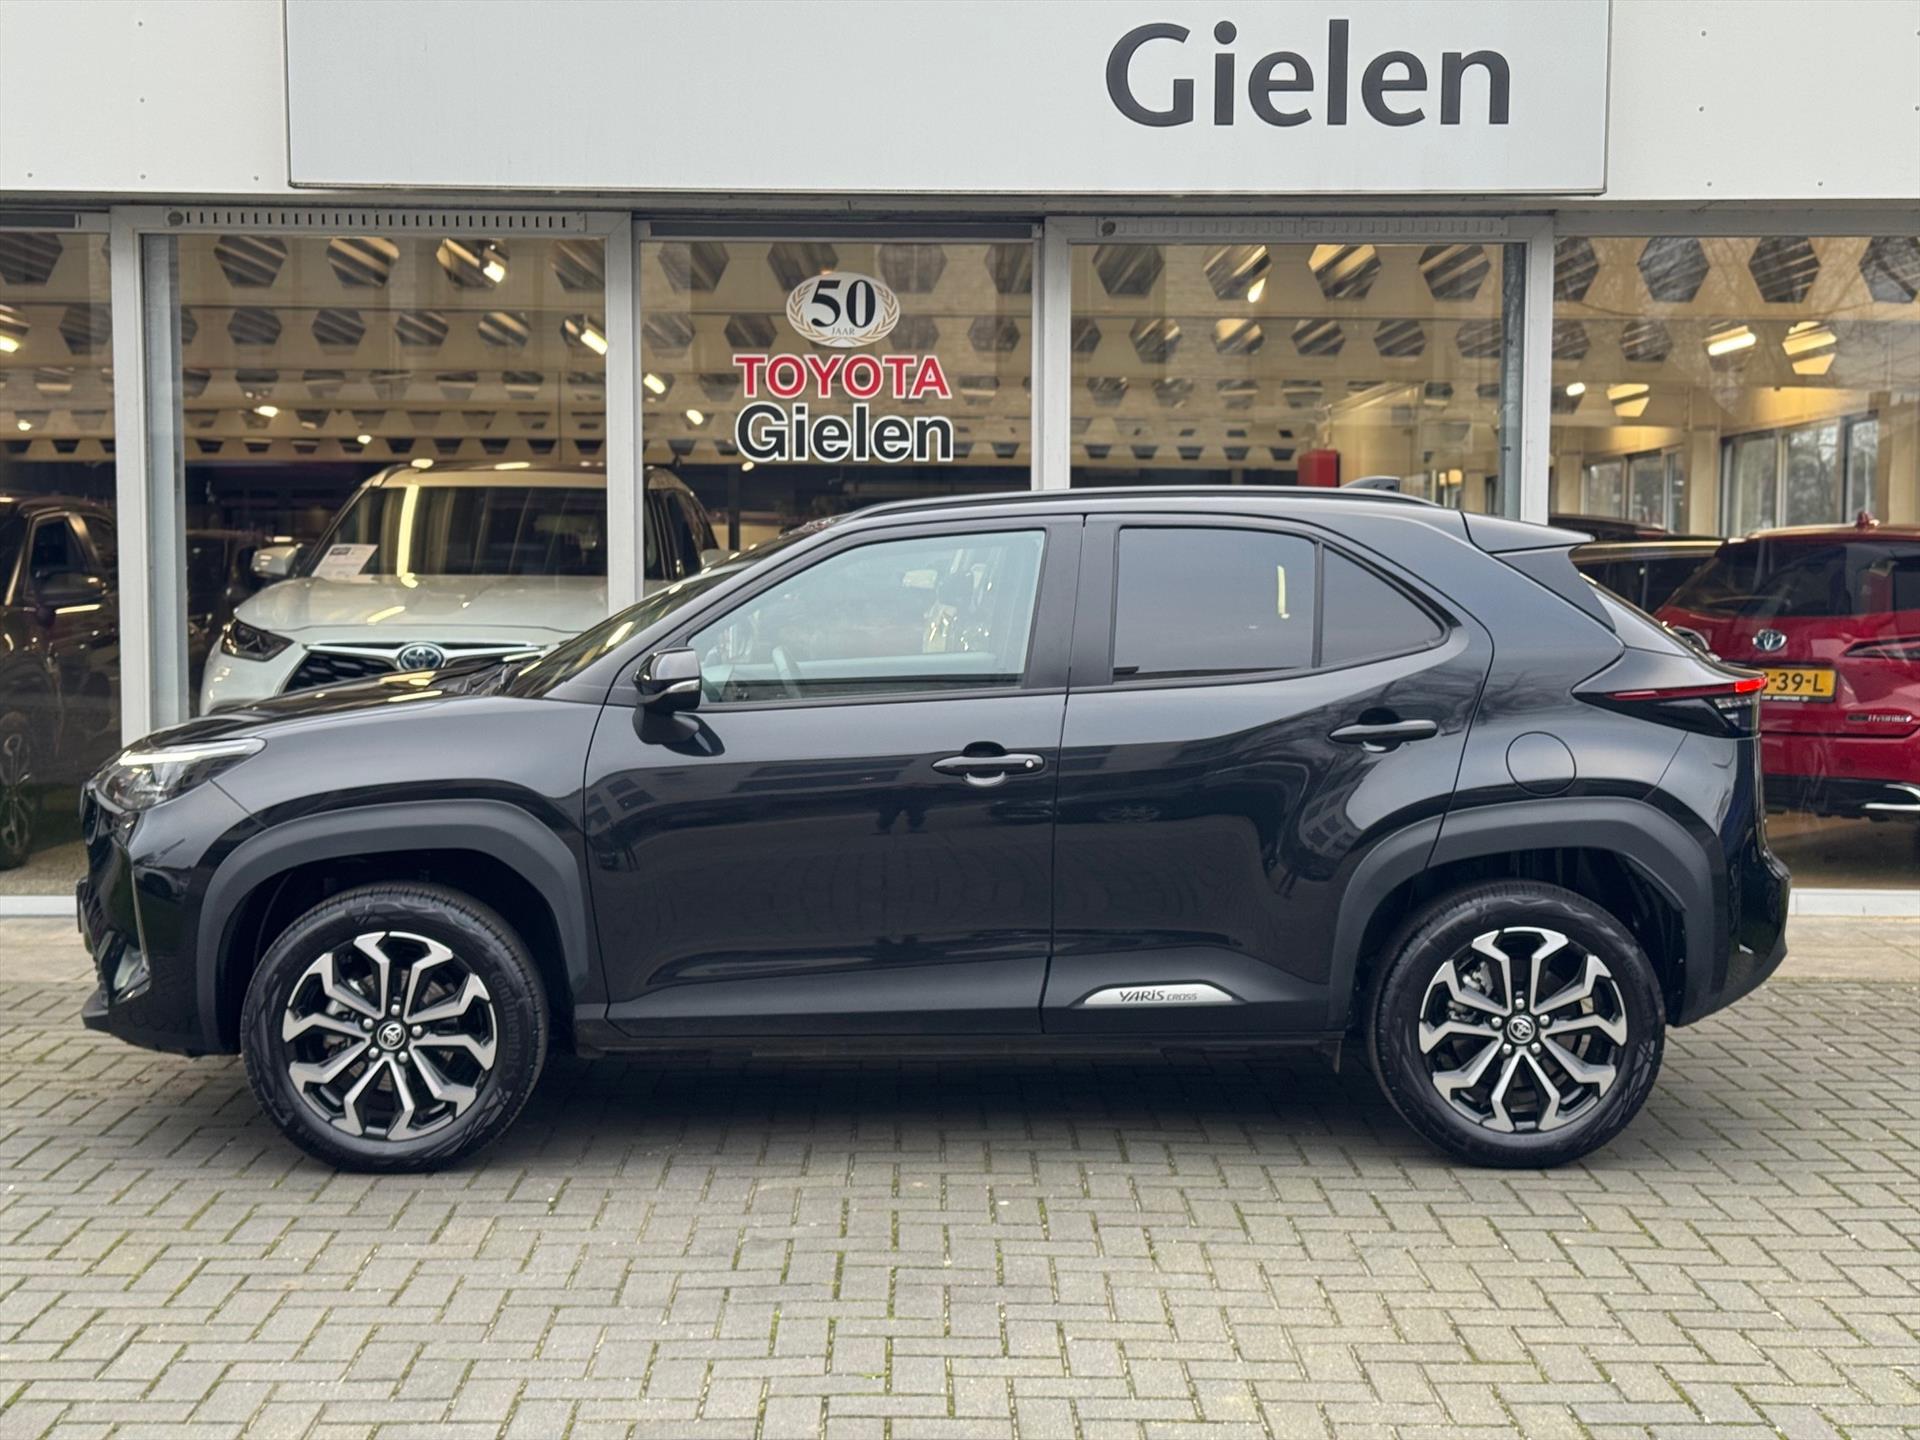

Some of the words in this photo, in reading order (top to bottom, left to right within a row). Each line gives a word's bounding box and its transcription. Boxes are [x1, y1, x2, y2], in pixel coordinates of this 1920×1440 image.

[1105, 18, 1511, 128] Gielen
[811, 279, 876, 328] 50
[831, 327, 856, 336] JAAR
[733, 354, 952, 399] TOYOTA
[735, 401, 954, 462] Gielen
[1763, 671, 1825, 692] -39-L
[1166, 992, 1198, 1001] CROSS
